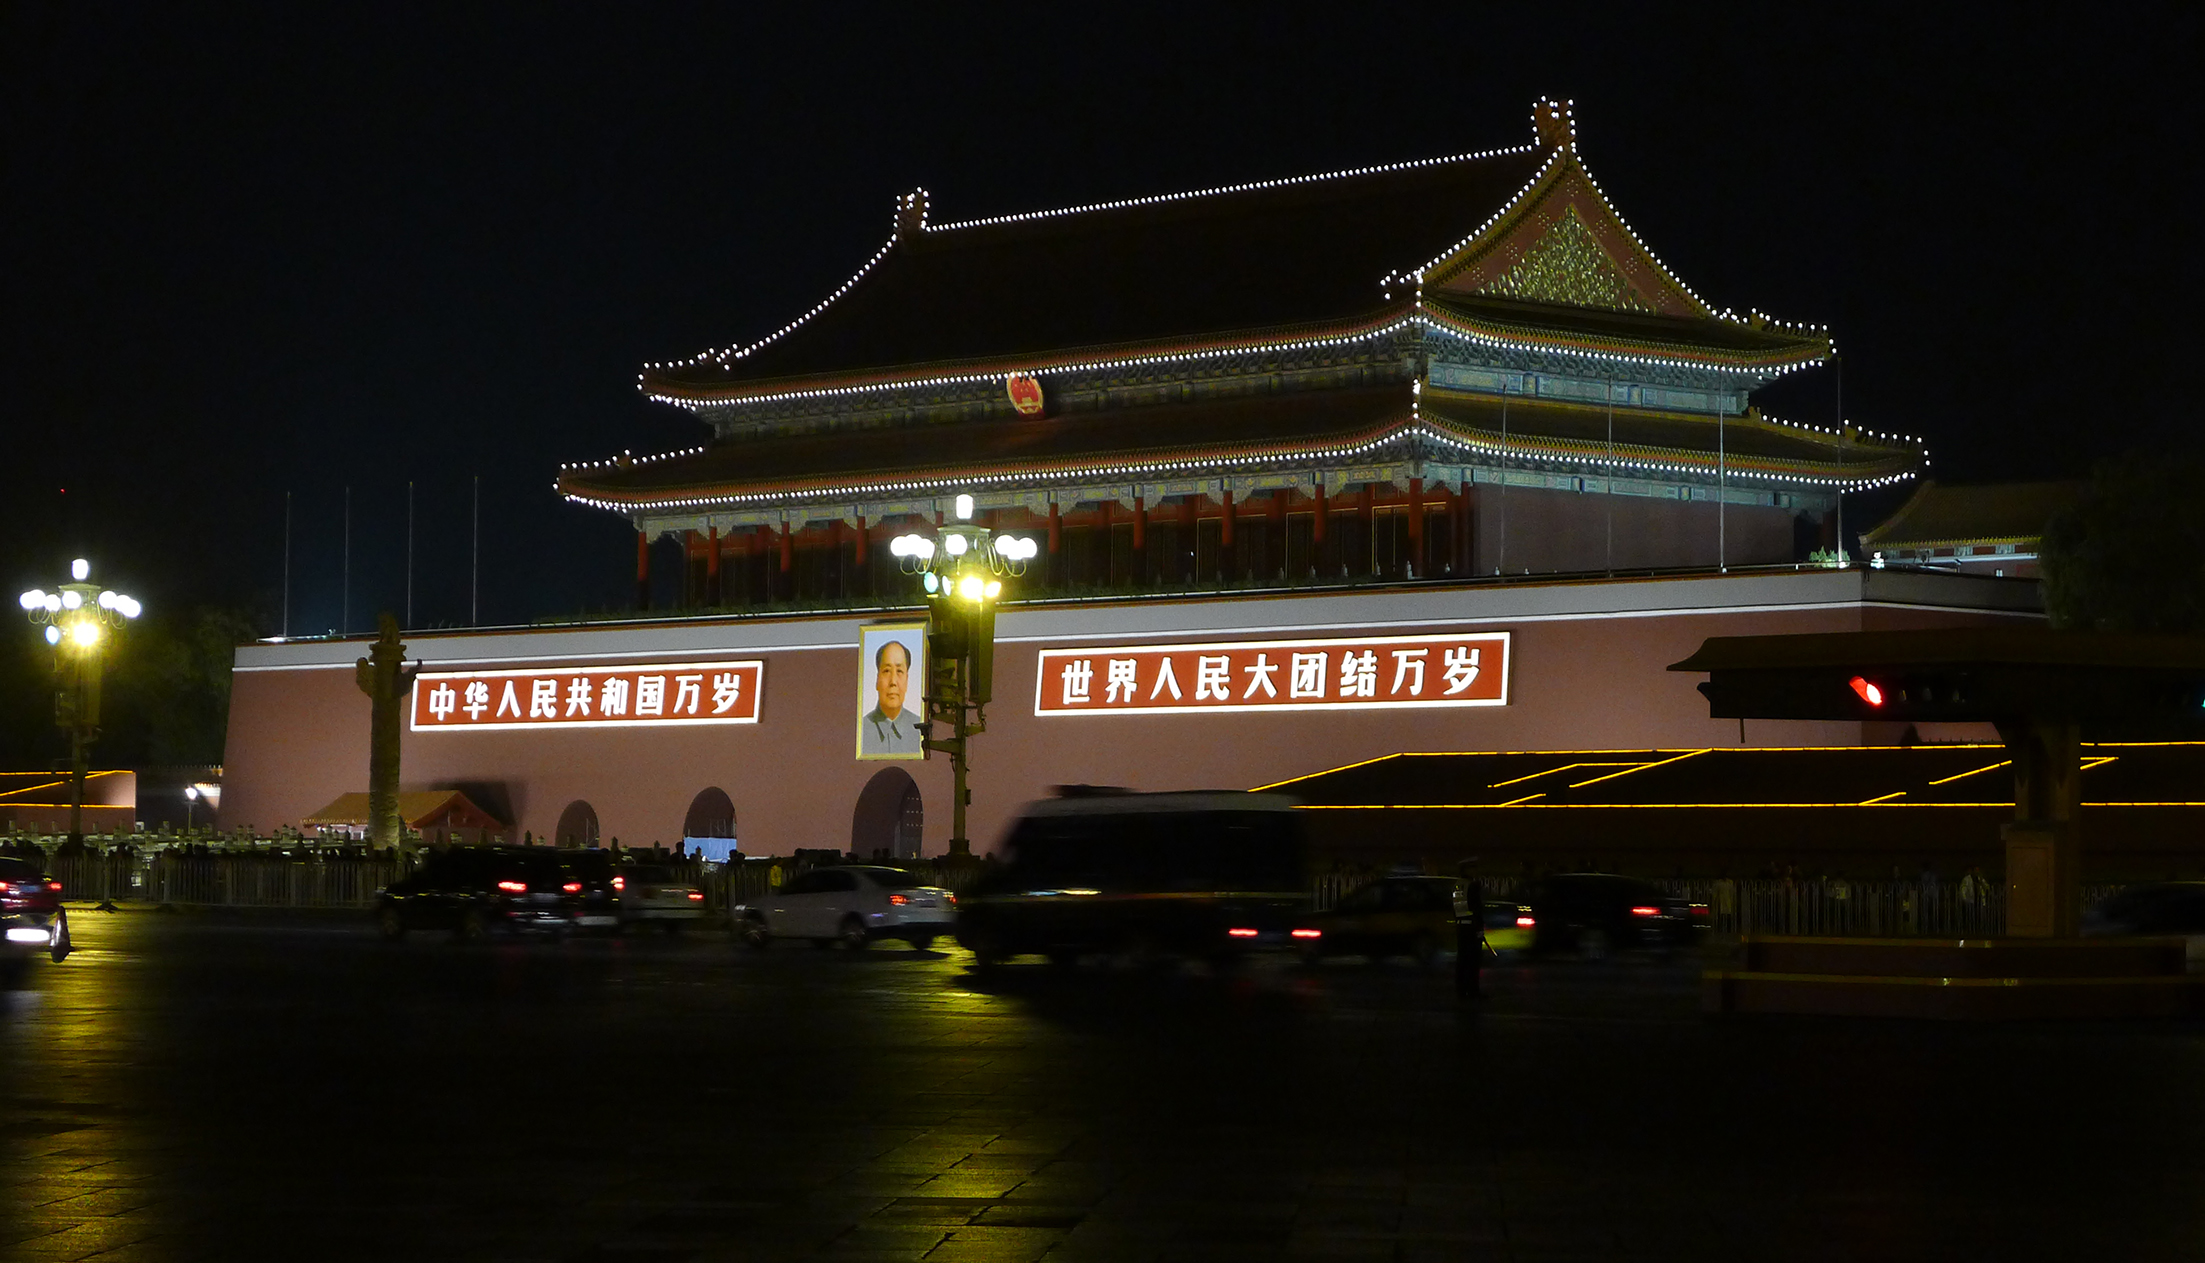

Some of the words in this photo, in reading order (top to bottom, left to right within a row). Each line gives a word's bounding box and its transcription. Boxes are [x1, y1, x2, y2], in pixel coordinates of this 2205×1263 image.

[428, 672, 741, 721] 中华人民共和国万岁
[1061, 646, 1480, 705] 世界人民大团结万岁
